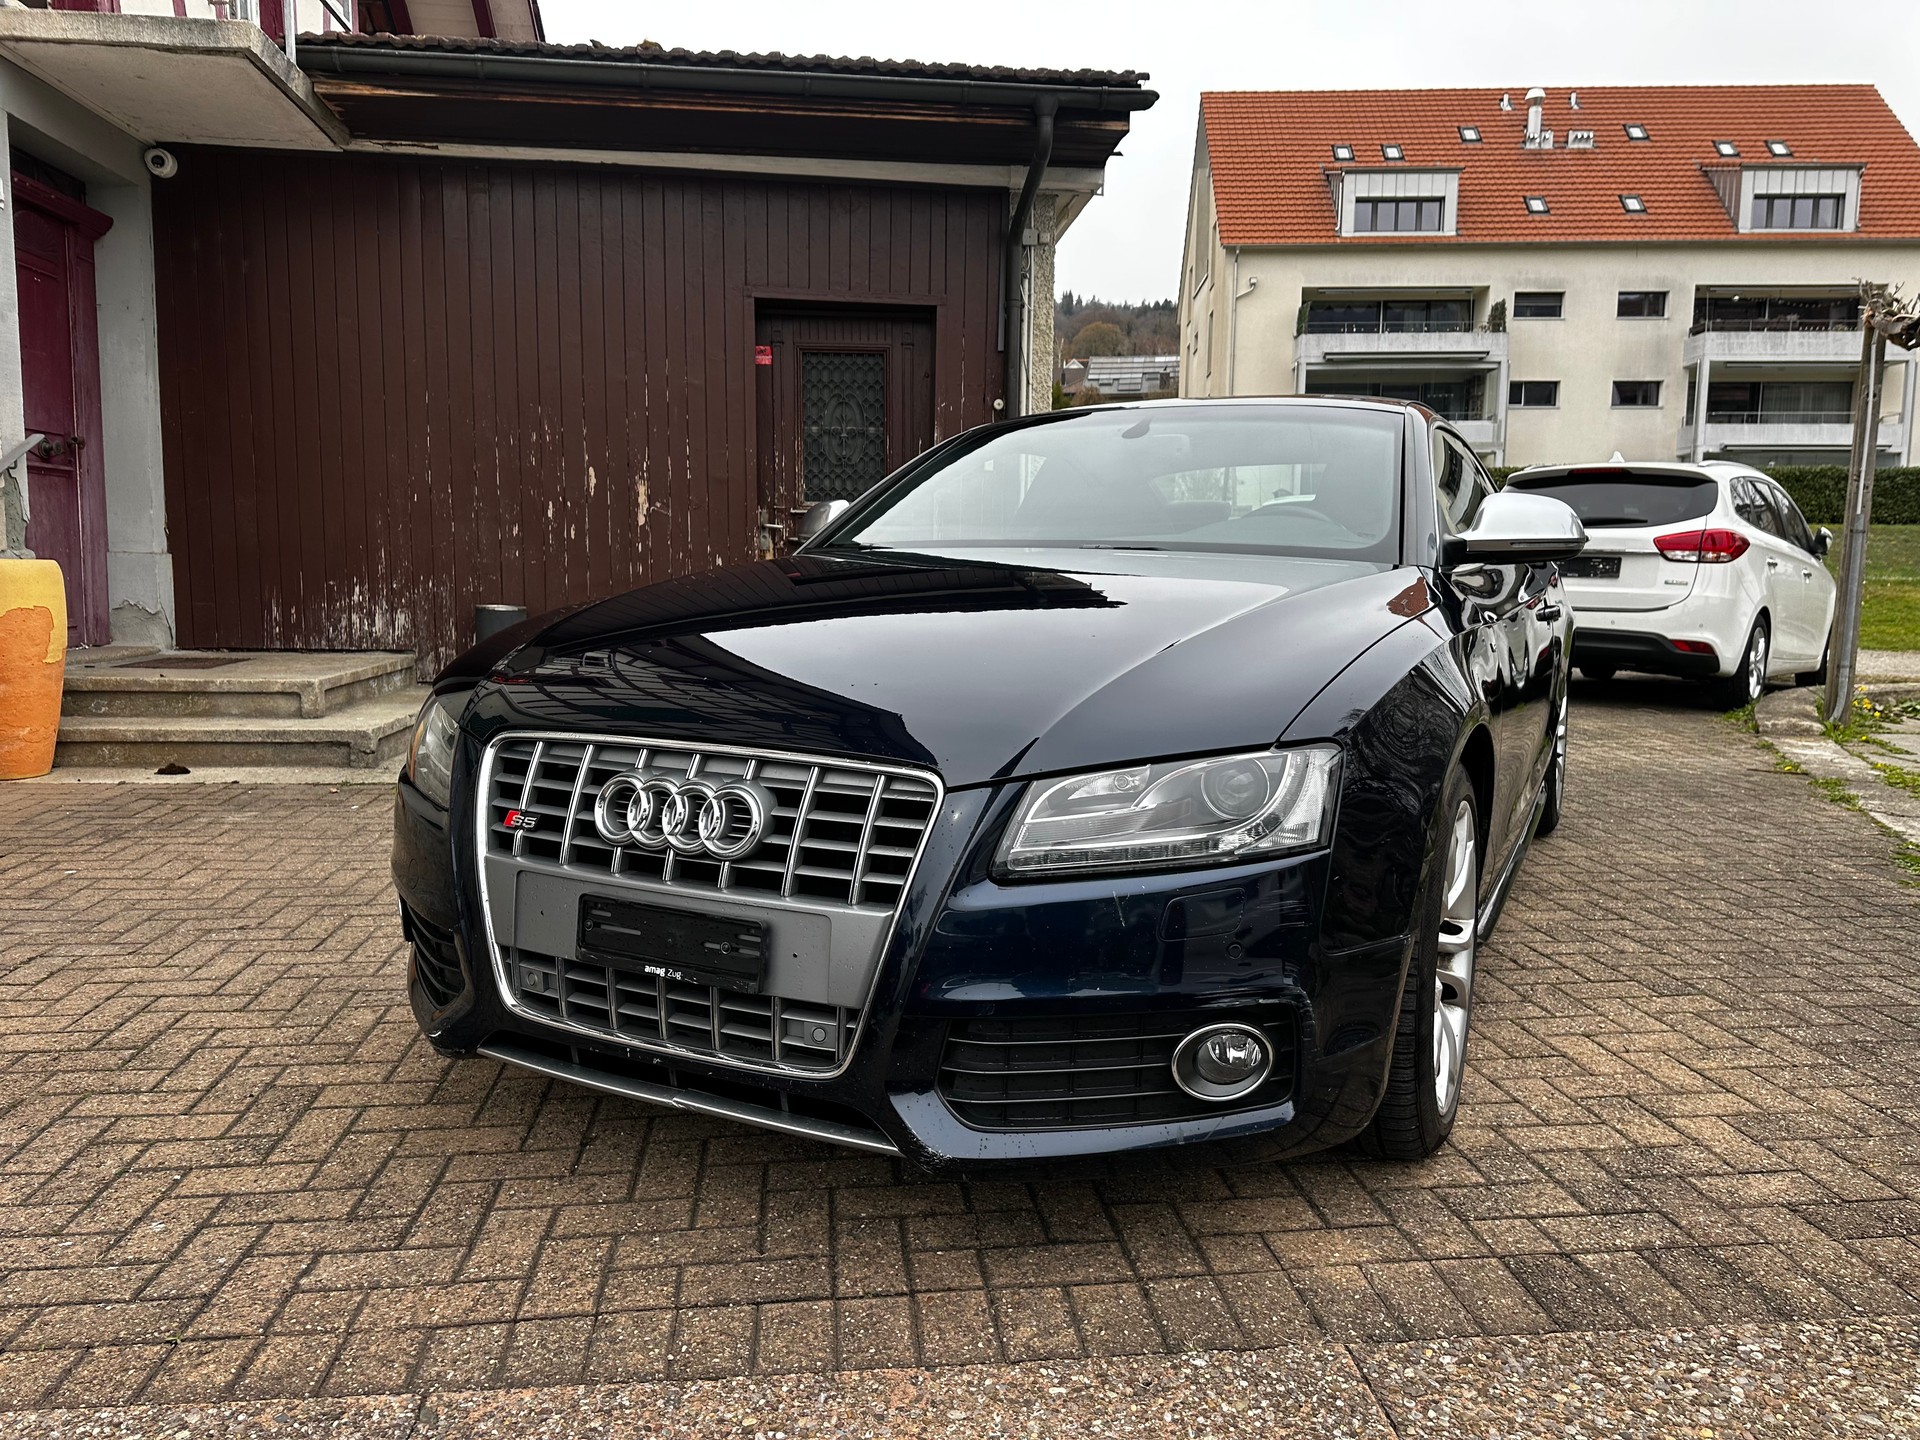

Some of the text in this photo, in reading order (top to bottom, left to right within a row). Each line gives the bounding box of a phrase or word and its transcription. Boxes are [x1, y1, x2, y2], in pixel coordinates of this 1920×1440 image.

[510, 814, 538, 828] S5
[644, 965, 682, 980] amag Zug
